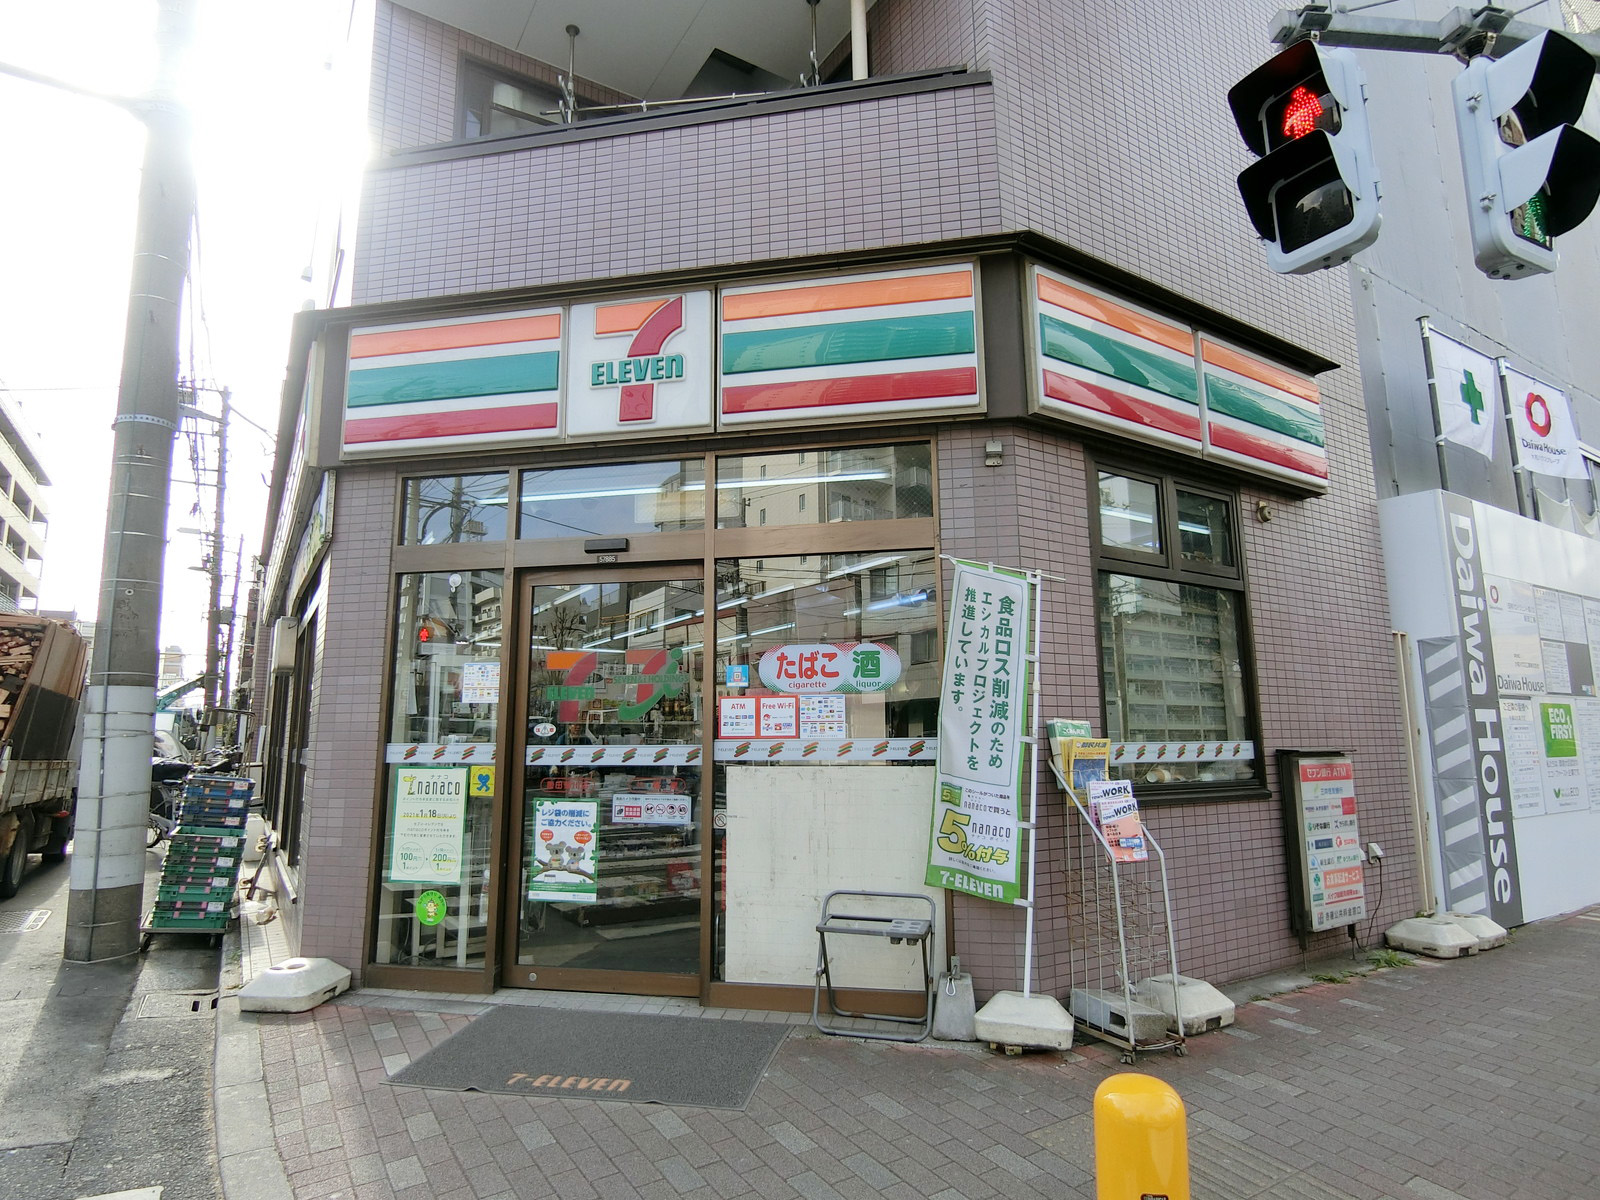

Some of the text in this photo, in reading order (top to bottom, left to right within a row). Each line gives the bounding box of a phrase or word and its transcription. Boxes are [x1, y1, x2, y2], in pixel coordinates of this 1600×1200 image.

[951, 586, 977, 712] 推進しています。
[776, 650, 839, 679] たばこ
[853, 650, 881, 679] 酒
[788, 680, 827, 690] cigarette
[855, 679, 882, 689] liquor
[967, 591, 992, 771] エシカルプロジェクトを
[989, 595, 1015, 769] 食品ロス削減のため
[1497, 675, 1545, 692] Daiwa House
[1450, 513, 1511, 904] Daiwa House
[1548, 708, 1565, 723] ECO
[1550, 719, 1573, 739] FIRST
[1307, 768, 1346, 778] セブン銀行 ATM
[417, 781, 460, 795] nanaco
[1102, 785, 1130, 798] WORK
[541, 809, 589, 818] レジ袋の削減に
[1114, 802, 1138, 816] WORK
[541, 818, 592, 828] ご協力ください。
[971, 823, 1011, 839] nanaco
